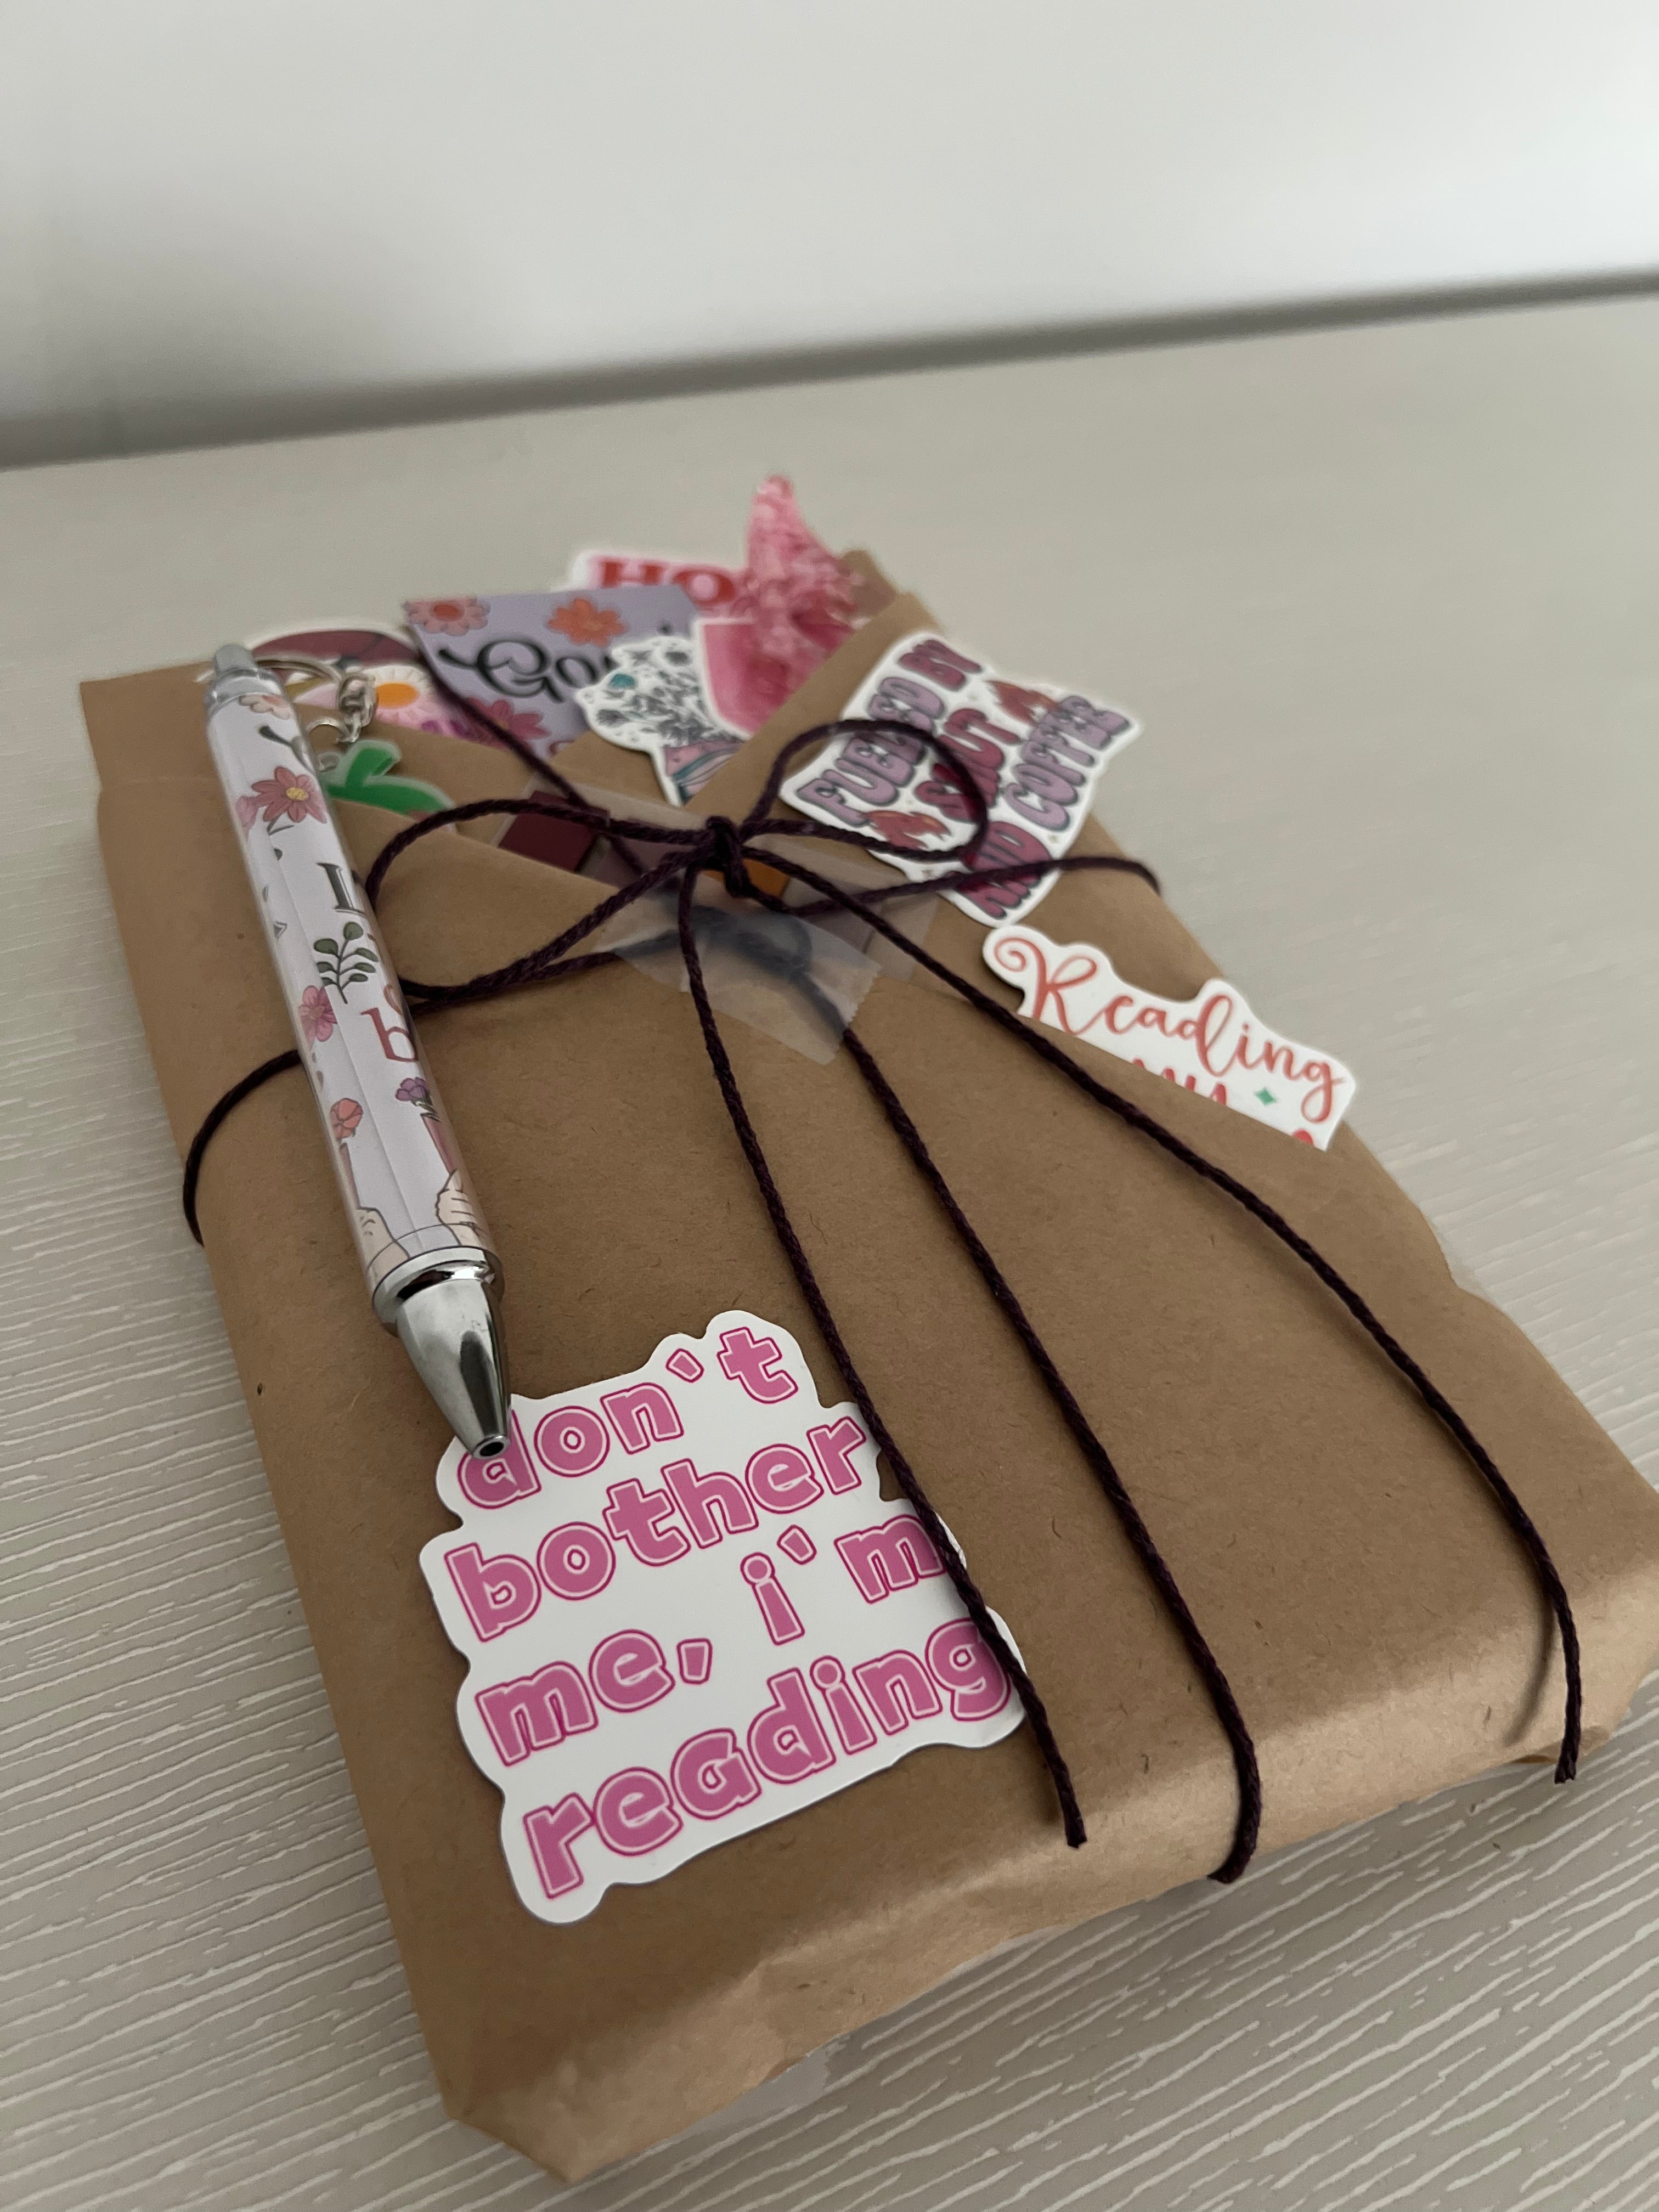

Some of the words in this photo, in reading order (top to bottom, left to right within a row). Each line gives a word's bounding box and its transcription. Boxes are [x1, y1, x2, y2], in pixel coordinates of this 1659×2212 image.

[438, 639, 617, 703] Go
[796, 676, 945, 827] FUELED
[896, 639, 983, 692] BY
[1005, 695, 1131, 832] COFFEE
[994, 937, 1345, 1124] Reading
[457, 1327, 798, 1509] don't
[444, 1416, 866, 1642] bother
[474, 1629, 713, 1767] me,
[741, 1514, 949, 1645] i'm
[523, 1617, 1011, 1899] reading
